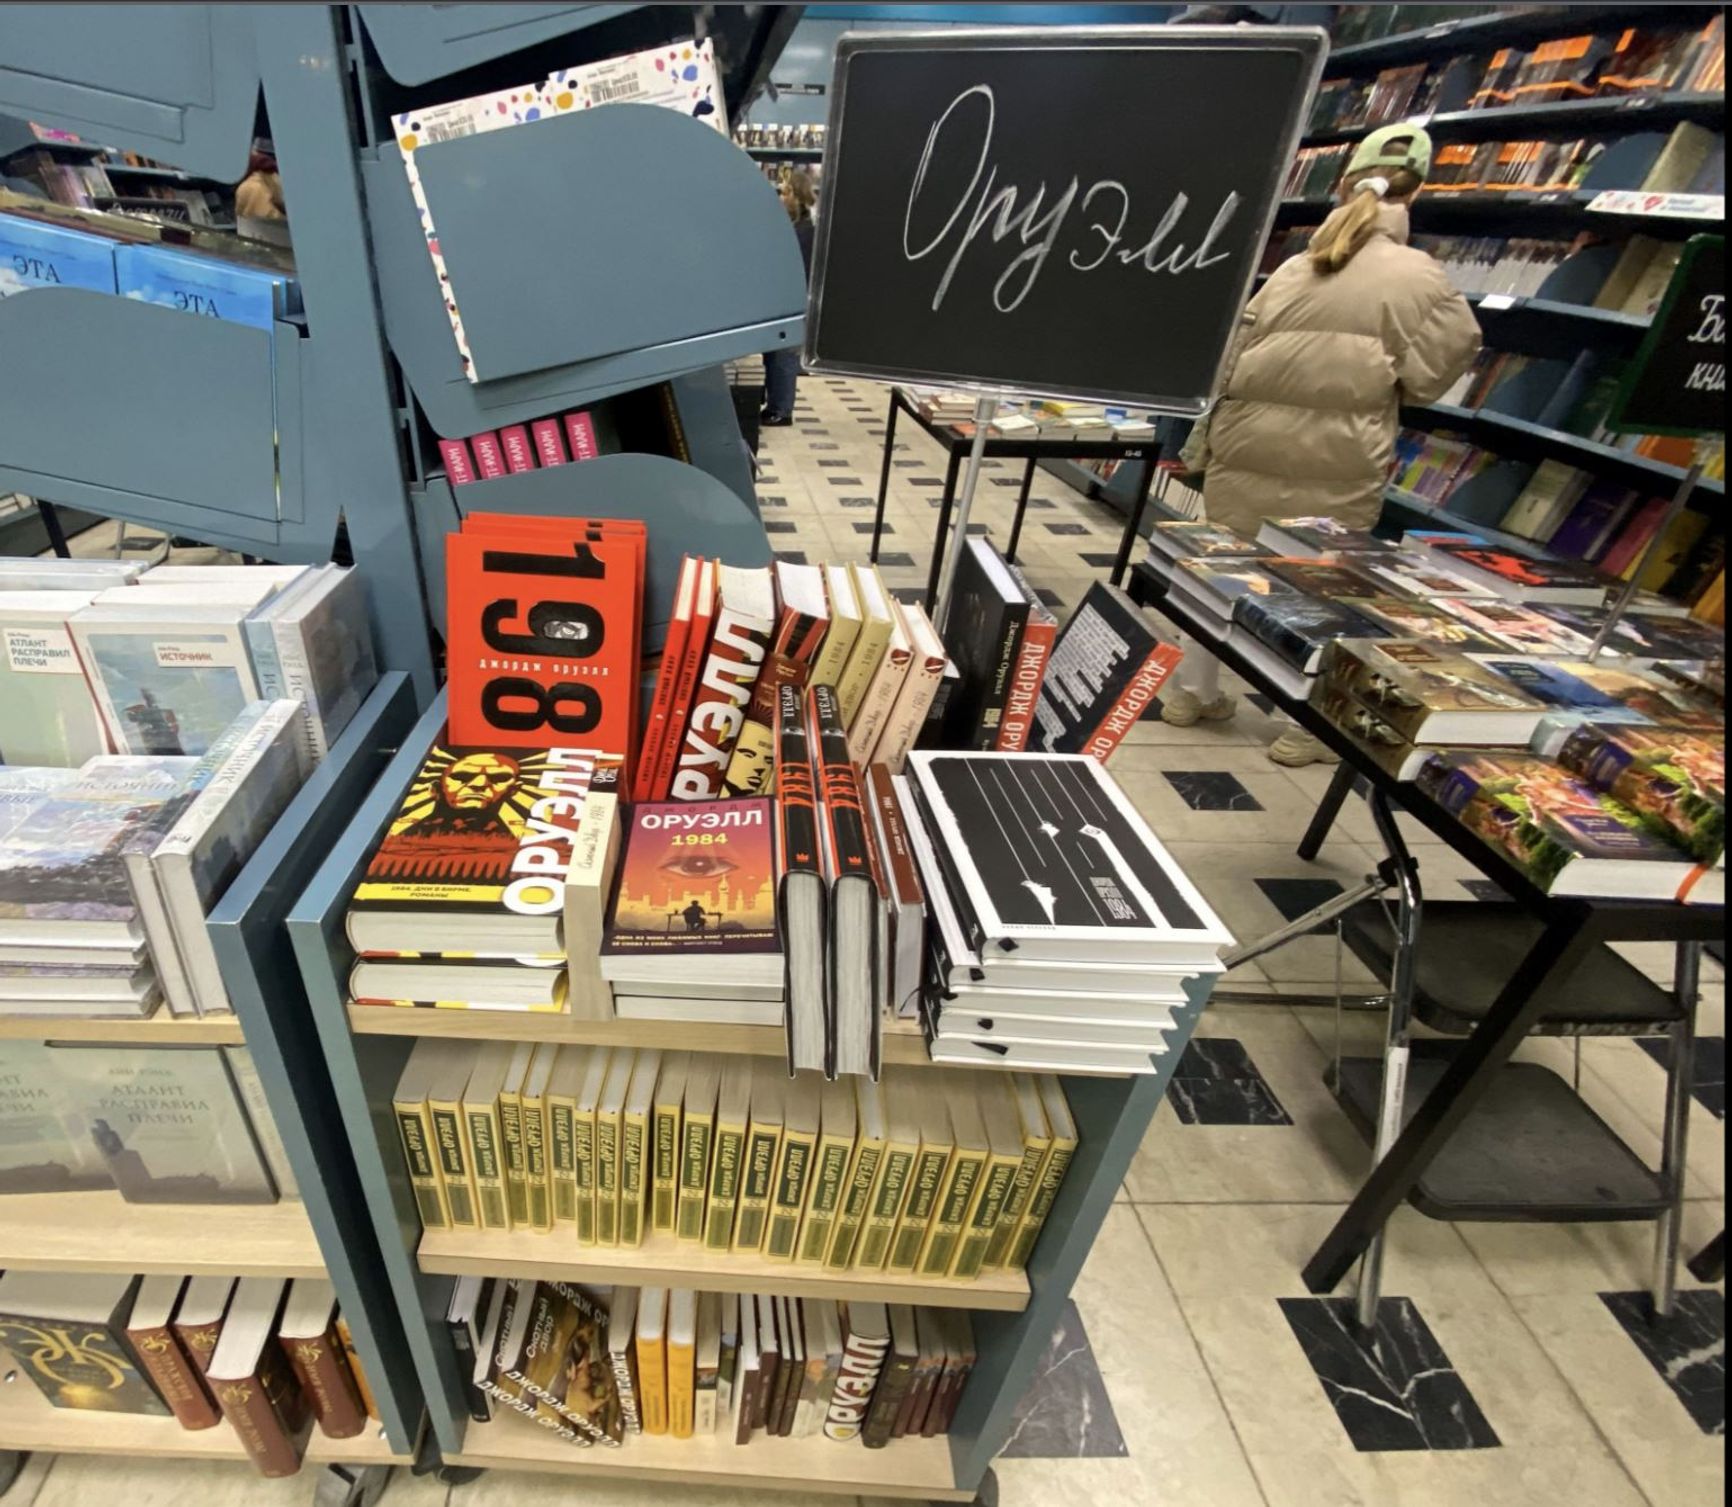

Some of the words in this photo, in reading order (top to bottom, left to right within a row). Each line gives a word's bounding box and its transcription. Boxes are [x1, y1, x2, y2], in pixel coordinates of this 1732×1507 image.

[904, 83, 1239, 312] Оруэлл
[13, 255, 61, 283] ЭТА
[174, 290, 220, 318] ЭТА
[9, 638, 48, 648] АТЛАНТ
[11, 648, 71, 658] РАСПРАВИЛ
[159, 651, 213, 662] ИСТОЧНИК
[1002, 620, 1020, 661] Джордж
[13, 656, 48, 667] ПЛЕЧИ
[553, 662, 609, 677] оруэлл
[1009, 642, 1046, 717] ДЖОРДЖ
[1104, 659, 1167, 735] ДЖОРДЖ
[640, 810, 762, 829] ОРУЭЛЛ
[671, 833, 728, 846] 1984
[101, 1099, 209, 1112] РАСПРАВИЛ
[112, 1085, 185, 1096] АТЛАНТ
[128, 1113, 194, 1125] ПЛЕЧИ
[403, 1118, 423, 1150] ОРУЭЛЛ
[438, 1116, 458, 1148] ОРУЭЛЛ
[473, 1116, 489, 1149] ОРУЭЛЛ
[504, 1105, 520, 1143] ОРУЭЛЛ
[526, 1108, 541, 1146] ОРУЭЛЛ
[555, 1107, 570, 1138] ОРУЭЛЛ
[660, 1118, 672, 1150] ОРУЭЛЛ
[578, 1125, 591, 1161] ОРУЭЛЛ
[599, 1125, 614, 1162] ОРУЭЛЛ
[625, 1126, 642, 1163] ОРУЭЛЛ
[689, 1126, 704, 1159] ОРУЭЛЛ
[721, 1135, 737, 1169] ОРУЭЛЛ
[754, 1140, 771, 1171] ОРУЭЛЛ
[787, 1148, 804, 1180] ОРУЭЛЛ
[824, 1148, 843, 1181] ОРУЭЛЛ
[854, 1150, 877, 1188] ОРУЭЛЛ
[886, 1155, 907, 1188] ОРУЭЛЛ
[919, 1156, 942, 1189] ОРУЭЛЛ
[953, 1162, 978, 1196] ОРУЭЛЛ
[1015, 1151, 1041, 1187] ОРУЭЛЛ
[1042, 1151, 1070, 1188] ОРУЭЛЛ
[988, 1167, 1010, 1200] ОРУЭЛЛ
[609, 1352, 631, 1396] ДЖОРДЖ
[620, 1397, 641, 1434] ОРУЭЛЛ
[823, 1333, 890, 1441] ОРУЭЛЛ
[476, 1380, 540, 1418] ДЖОРДЖ
[537, 1416, 593, 1448] ОРУЭЛЛ
[505, 1370, 570, 1413] ДЖОРДЖ
[566, 1412, 622, 1448] ОРУЭЛЛ
